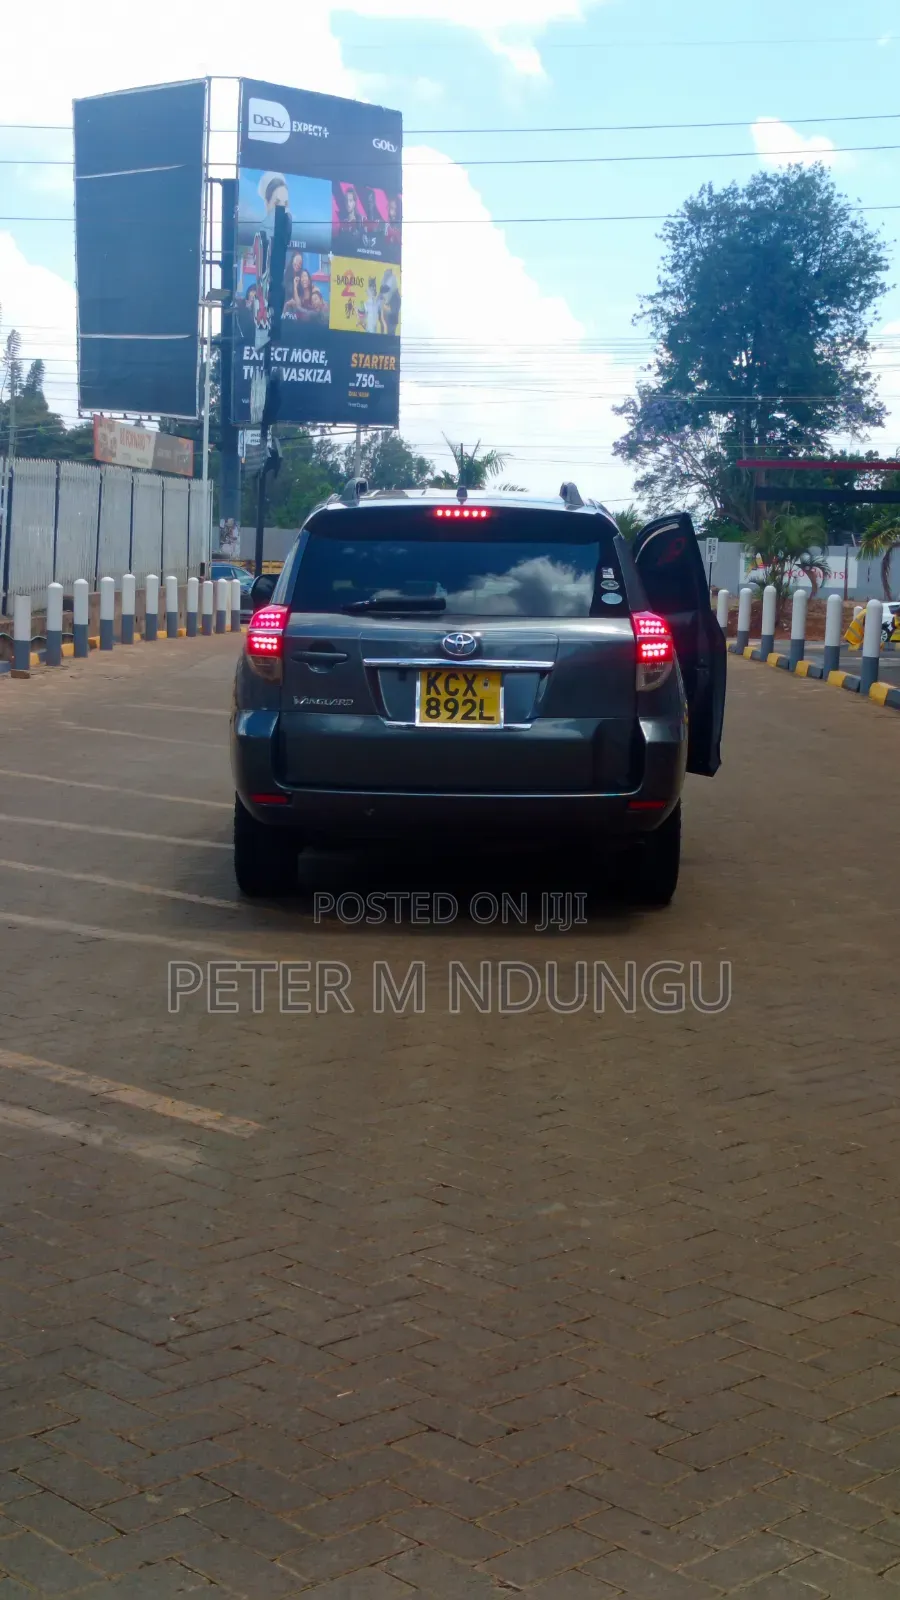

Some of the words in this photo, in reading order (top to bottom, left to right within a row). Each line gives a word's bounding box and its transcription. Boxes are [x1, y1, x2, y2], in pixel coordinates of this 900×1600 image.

[253, 113, 285, 129] DStv
[372, 138, 398, 153] GOtv
[290, 348, 328, 366] MORE,
[351, 352, 396, 370] STARTER
[355, 373, 375, 388] 750
[425, 671, 478, 697] KCX
[425, 697, 495, 721] 892L
